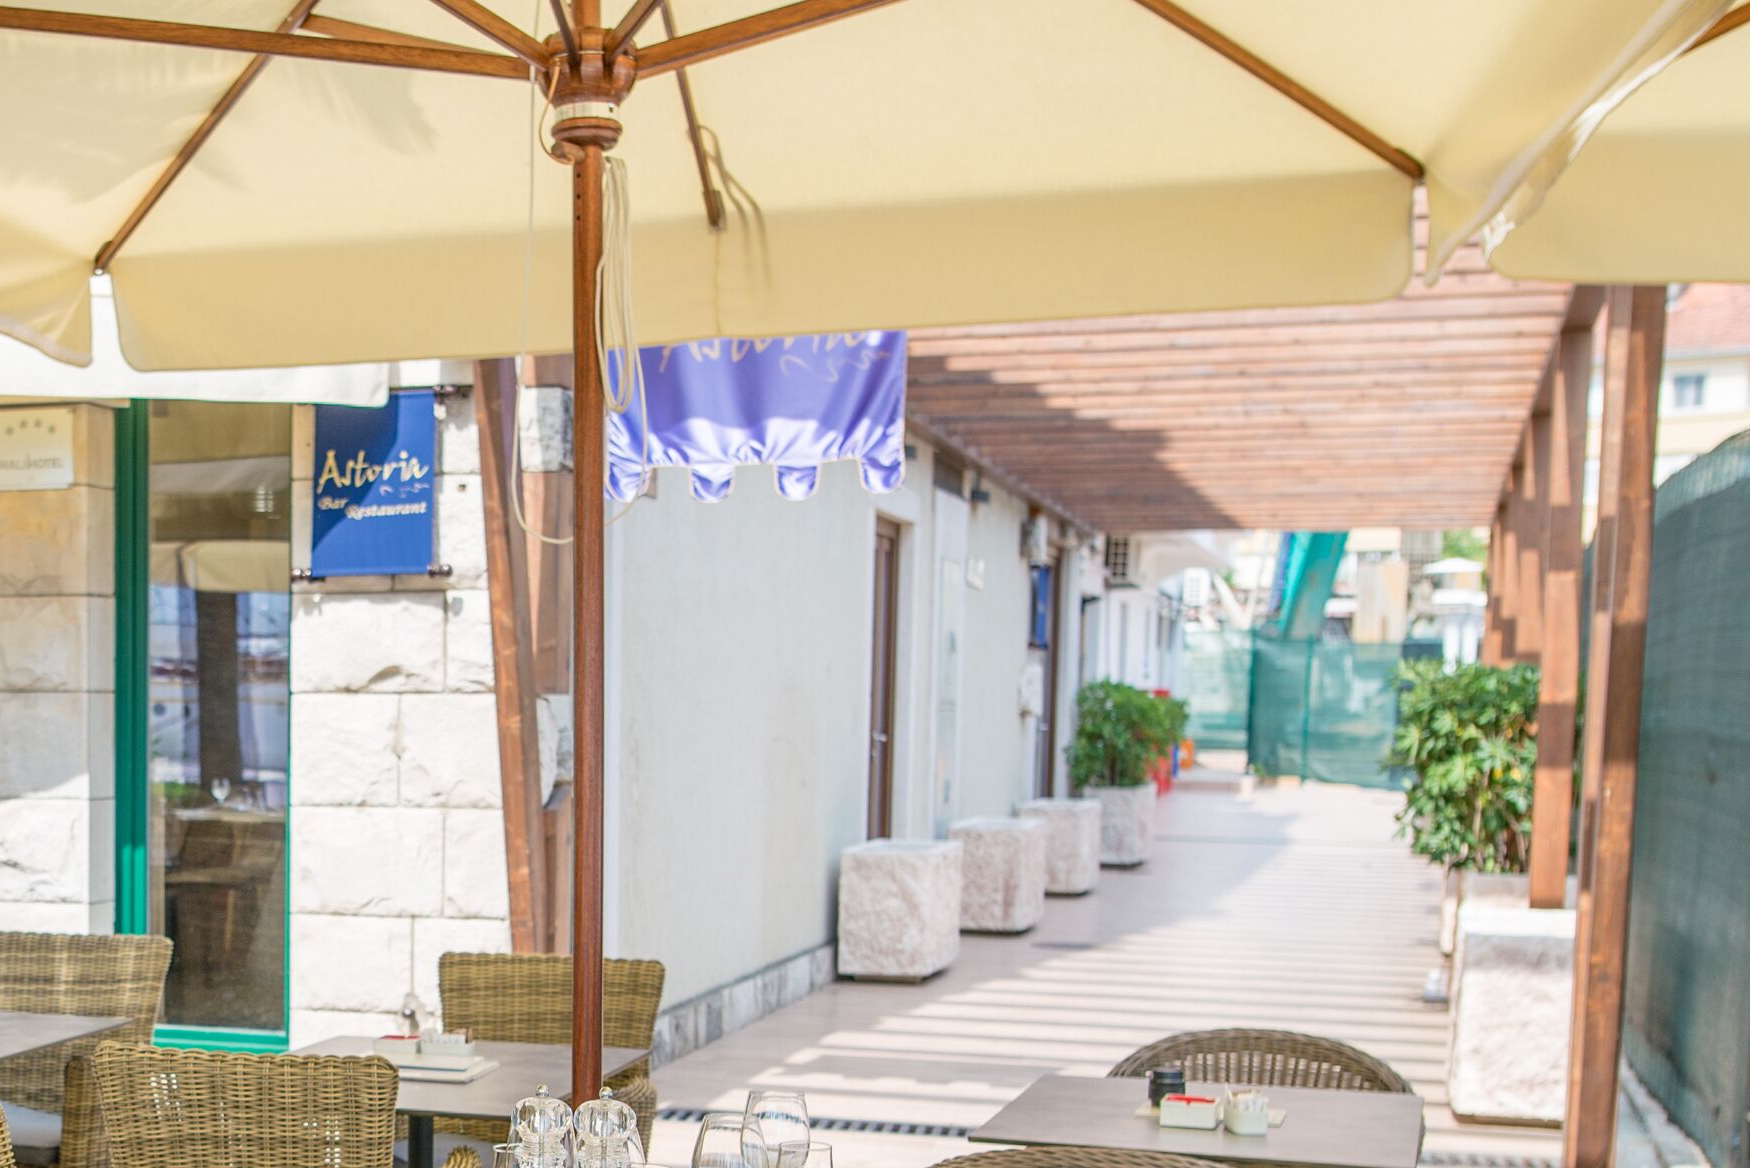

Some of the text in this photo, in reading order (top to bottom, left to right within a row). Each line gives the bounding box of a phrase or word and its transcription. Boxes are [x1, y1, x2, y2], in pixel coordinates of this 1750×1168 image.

[317, 449, 430, 494] Astoria
[319, 497, 428, 520] Bar Restaurant
